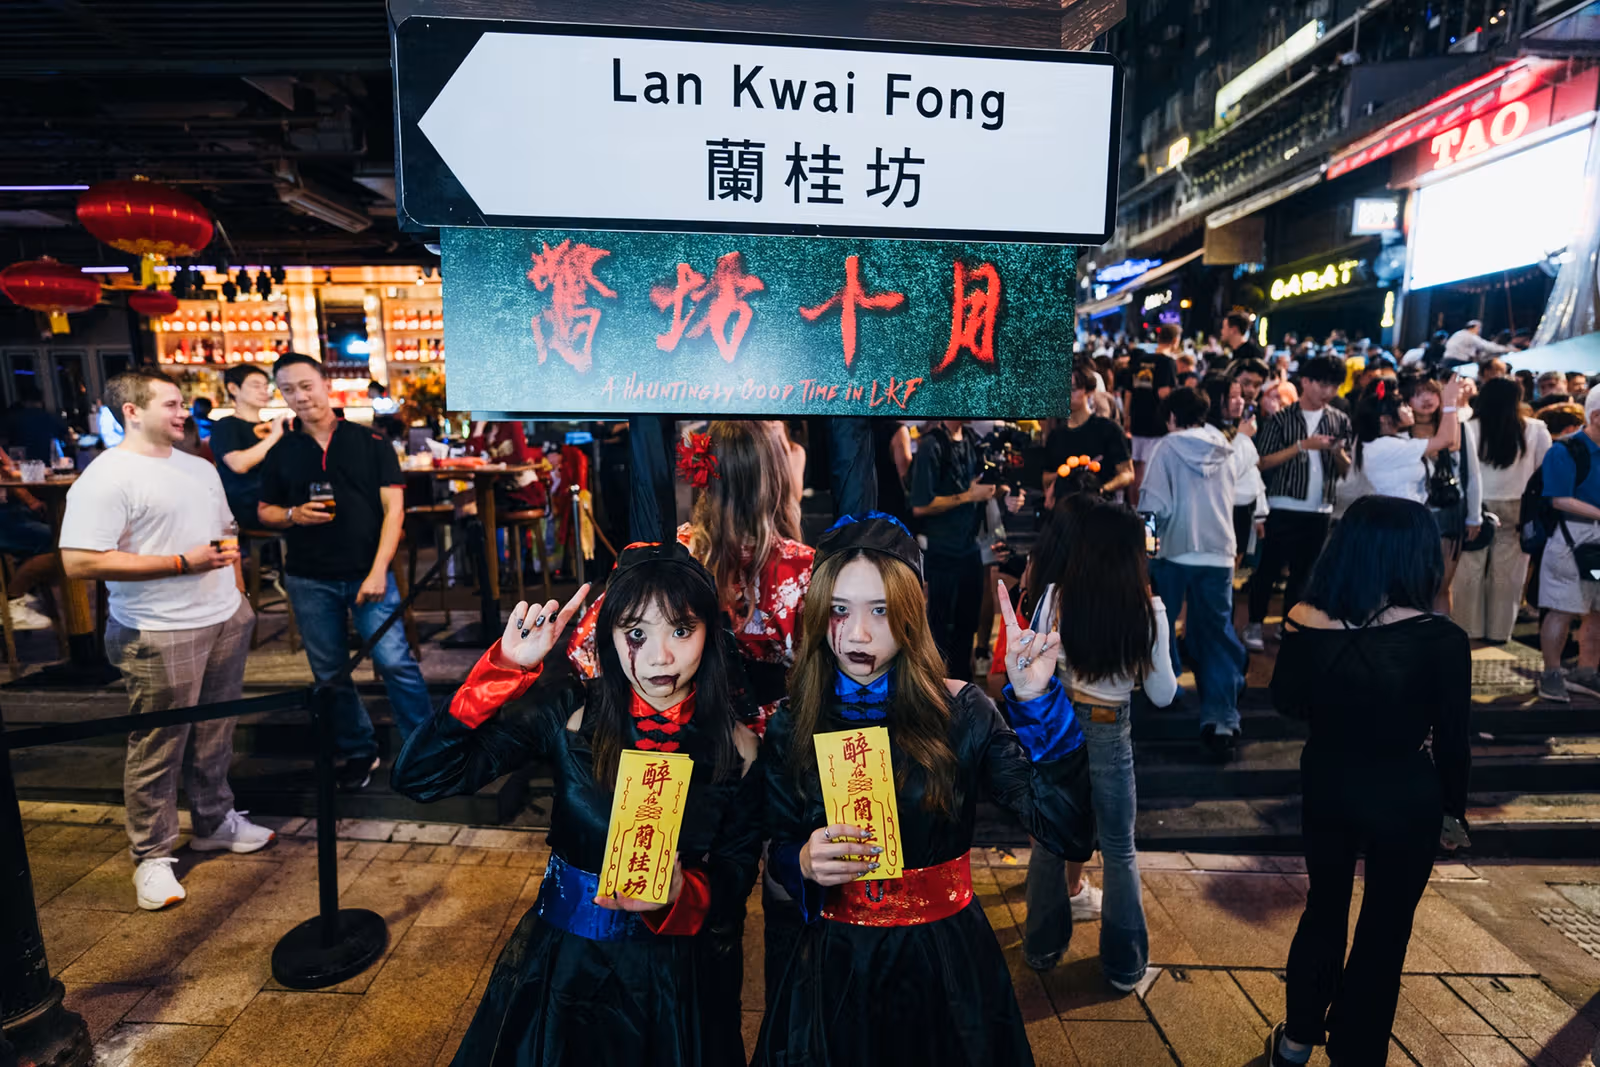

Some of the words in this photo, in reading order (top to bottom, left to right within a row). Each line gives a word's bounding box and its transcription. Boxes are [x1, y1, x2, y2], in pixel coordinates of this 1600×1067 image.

[612, 57, 702, 105] Lan
[732, 64, 855, 113] Kwai
[885, 72, 1005, 131] Fong
[1431, 101, 1530, 170] TAO
[705, 137, 925, 208] 蘭桂坊
[601, 376, 615, 404] A
[869, 376, 924, 410] LKF
